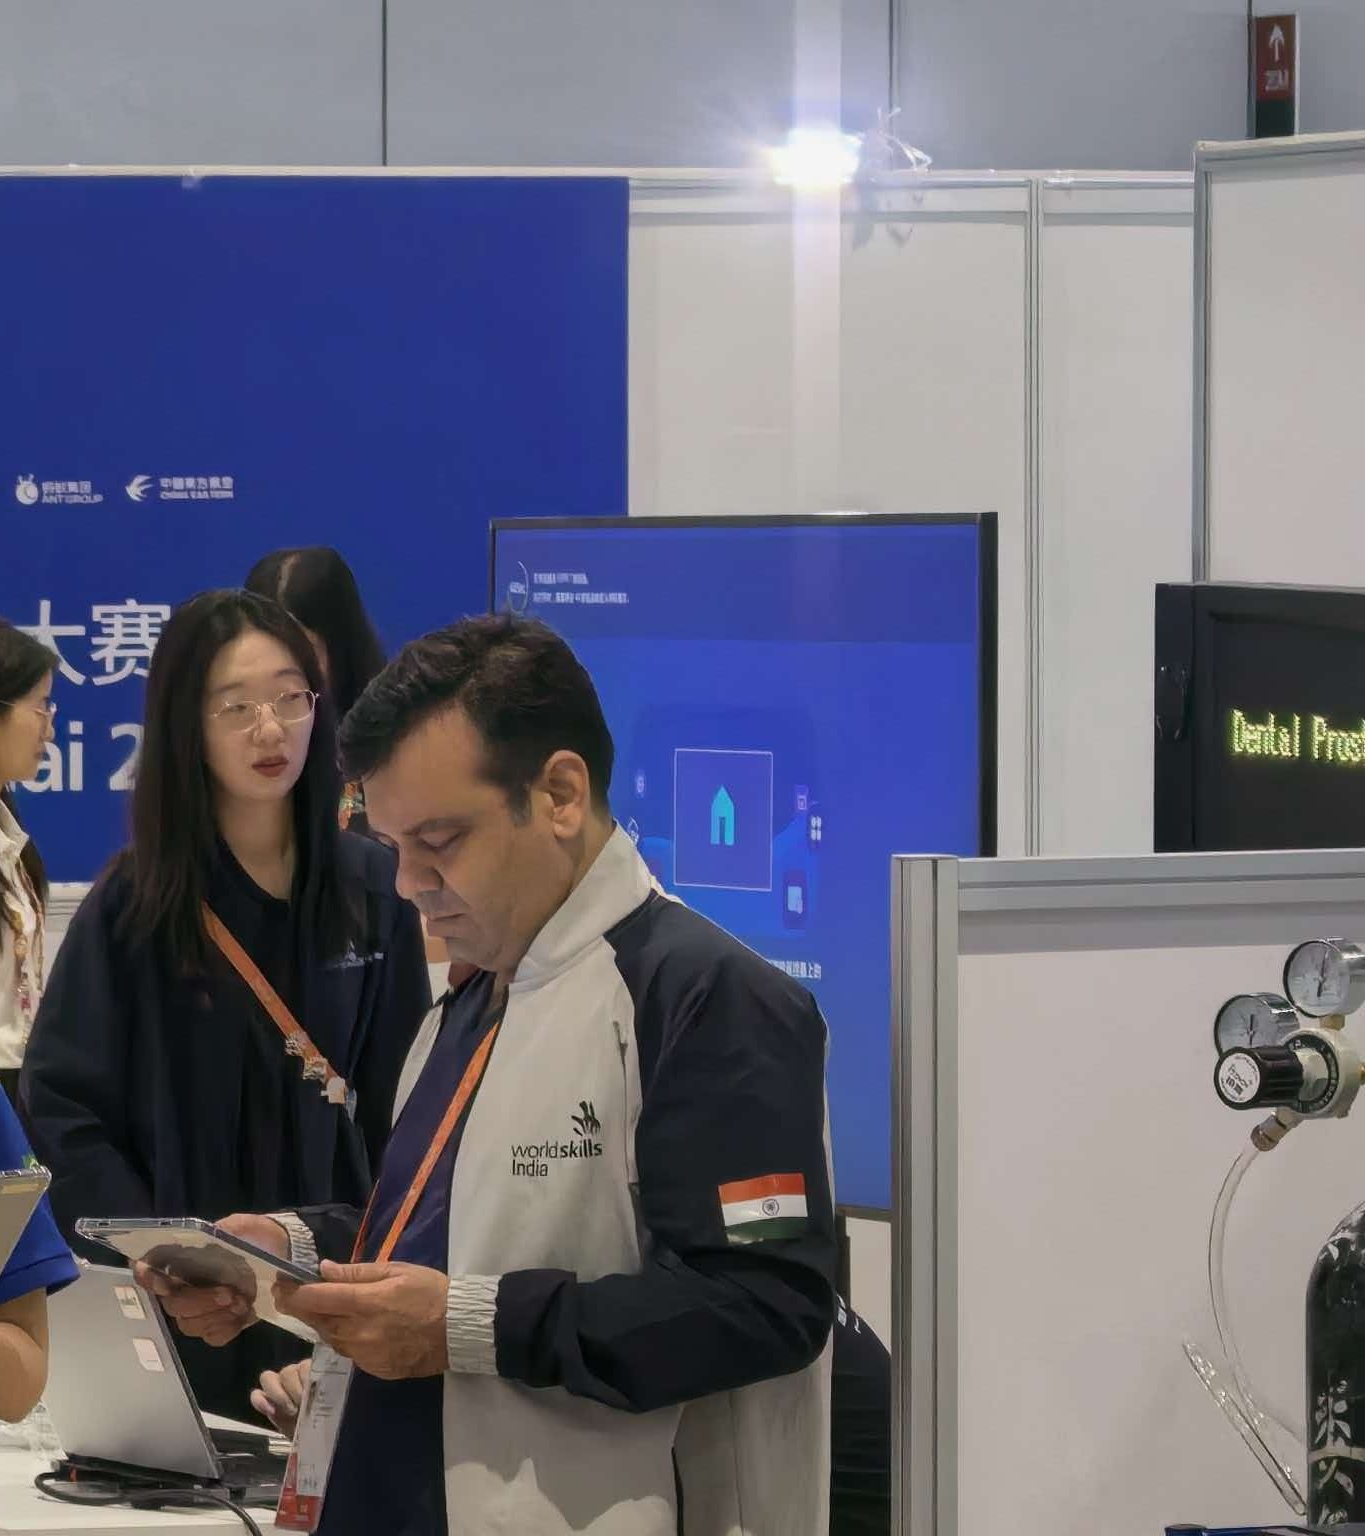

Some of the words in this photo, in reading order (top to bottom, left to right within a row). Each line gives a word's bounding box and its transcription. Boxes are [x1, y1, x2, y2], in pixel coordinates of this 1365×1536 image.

[1233, 709, 1301, 757] Dental
[511, 1139, 603, 1159] worldskills
[512, 1160, 549, 1177] India
